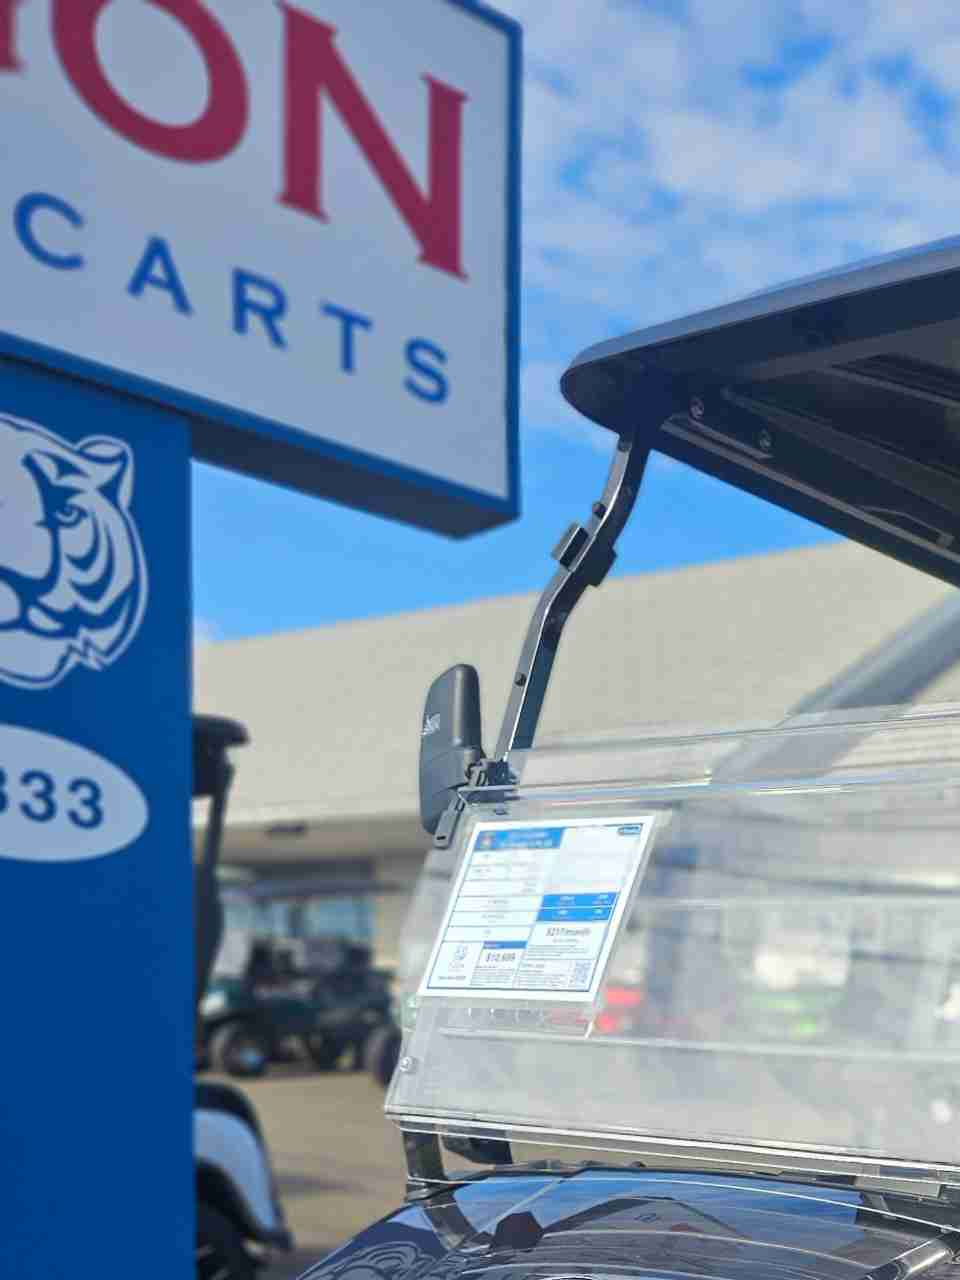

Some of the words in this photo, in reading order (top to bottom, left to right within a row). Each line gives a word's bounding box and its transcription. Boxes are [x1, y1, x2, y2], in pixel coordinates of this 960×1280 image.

[0, 0, 468, 282] ON
[13, 191, 449, 406] CARTS
[0, 766, 104, 830] 33
